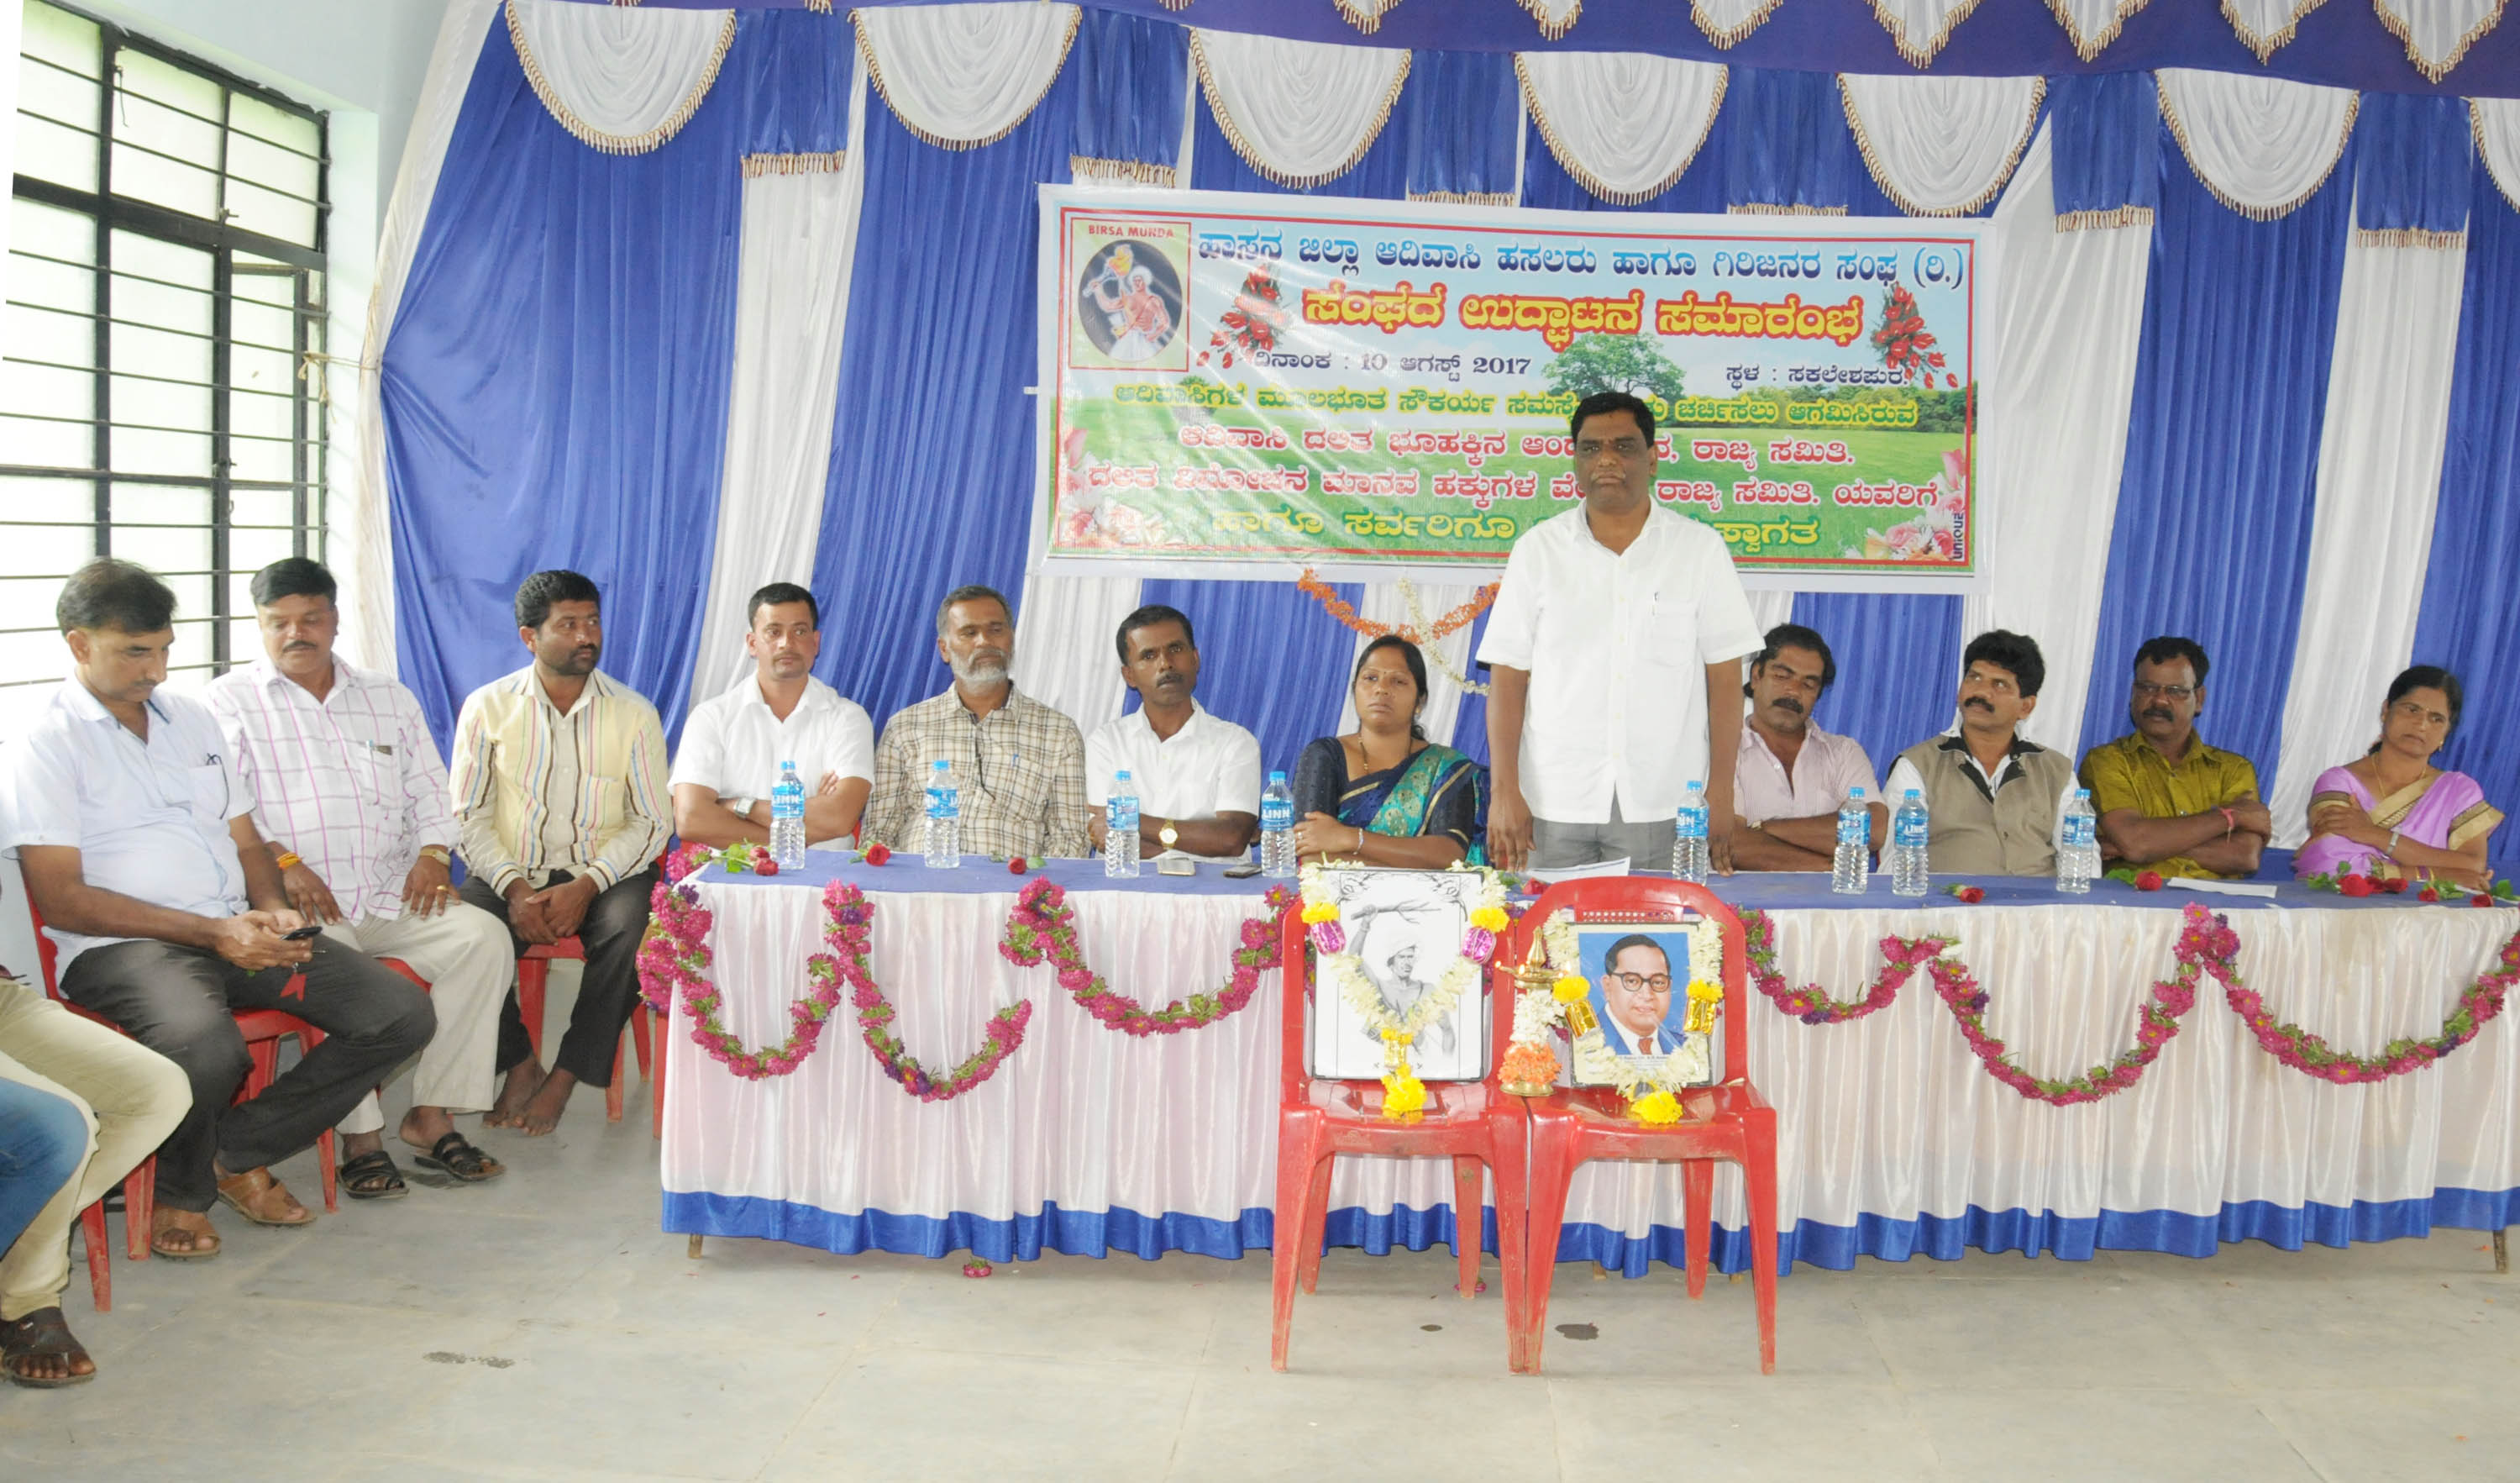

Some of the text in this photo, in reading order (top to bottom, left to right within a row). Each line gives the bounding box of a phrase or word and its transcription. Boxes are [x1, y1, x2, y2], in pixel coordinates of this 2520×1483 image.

[1088, 224, 1174, 238] BIRSA MUNDA
[1199, 229, 1963, 289] ಹಾಸನ ಜಿಲ್ಲಾ ಆದಿವಾಸಿ ಹಸಲರು ಹಾಗೂ ಗಿರಿಜನರ ಸಂಘ (ರಿ.)
[1304, 280, 1862, 350] ಸಂಘದ ಉದ್ಘಾಟನ ಸಮಾರಂಭ
[1255, 350, 1331, 368] ದಿನಾಂಕ
[1361, 353, 1388, 371] 10
[1400, 355, 1461, 382] ಆಗಸ್ಟ್
[1473, 356, 1532, 375] 2017
[1726, 363, 1760, 392] ಸ್ಥಳ
[1115, 382, 1247, 408] ಆದಿವಾಸಿಗಳ
[1257, 387, 1388, 413] ಮೂಲಭೂತ
[1398, 387, 1496, 414] ಸೌಕರ್ಯ
[1677, 395, 1778, 423] ಚರ್ಚಿಸಲು
[1788, 398, 1918, 425] ಆಗಮಿಸಿರುವ
[1179, 425, 1289, 450] ಆದಿವಾಸಿ
[1304, 427, 1373, 451] ದಲಿತ
[1389, 429, 1506, 466] ಭೂಹಕ್ಕಿನ
[1693, 439, 1757, 471] ರಾಜ್ಯ
[1770, 438, 1854, 463] ಸಮಿತಿ.
[1323, 469, 1418, 494] ಮಾನವ
[1433, 470, 1536, 508] ಹಕ್ಕುಗಳ
[1656, 480, 1721, 511] ರಾಜ್ಯ
[1735, 476, 1820, 504] ಸಮಿತಿ.
[1834, 479, 1939, 506] ಯವರಿಗೆ
[1212, 507, 1324, 534] ಹಾಗೂ
[1344, 509, 1516, 538] ಸರ್ವರಿಗೂ
